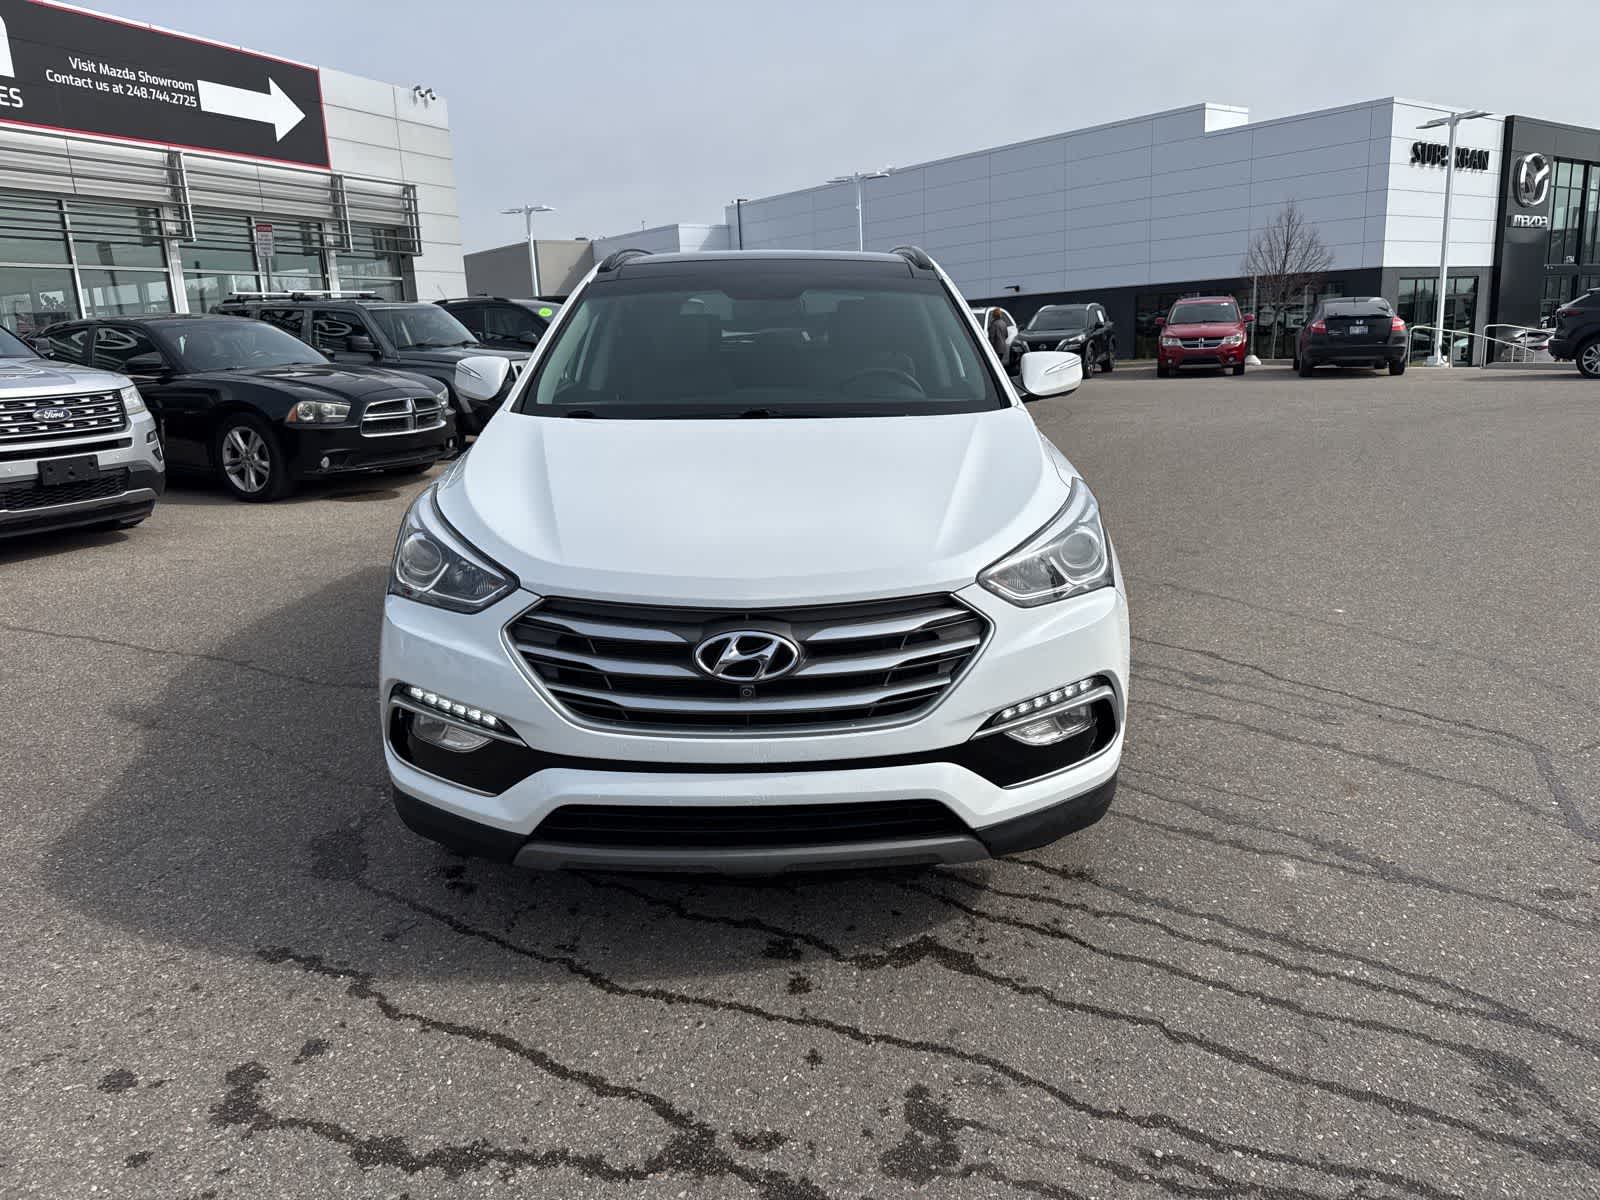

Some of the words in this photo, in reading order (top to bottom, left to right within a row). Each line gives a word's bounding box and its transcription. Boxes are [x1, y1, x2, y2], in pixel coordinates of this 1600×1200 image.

[46, 69, 93, 88] Contact
[95, 80, 110, 92] us
[111, 82, 124, 95] at
[126, 84, 197, 107] 248.744.2725
[68, 56, 96, 73] Visit
[99, 63, 136, 80] Mazda
[138, 71, 195, 92] Showroom
[43, 410, 65, 419] Ford
